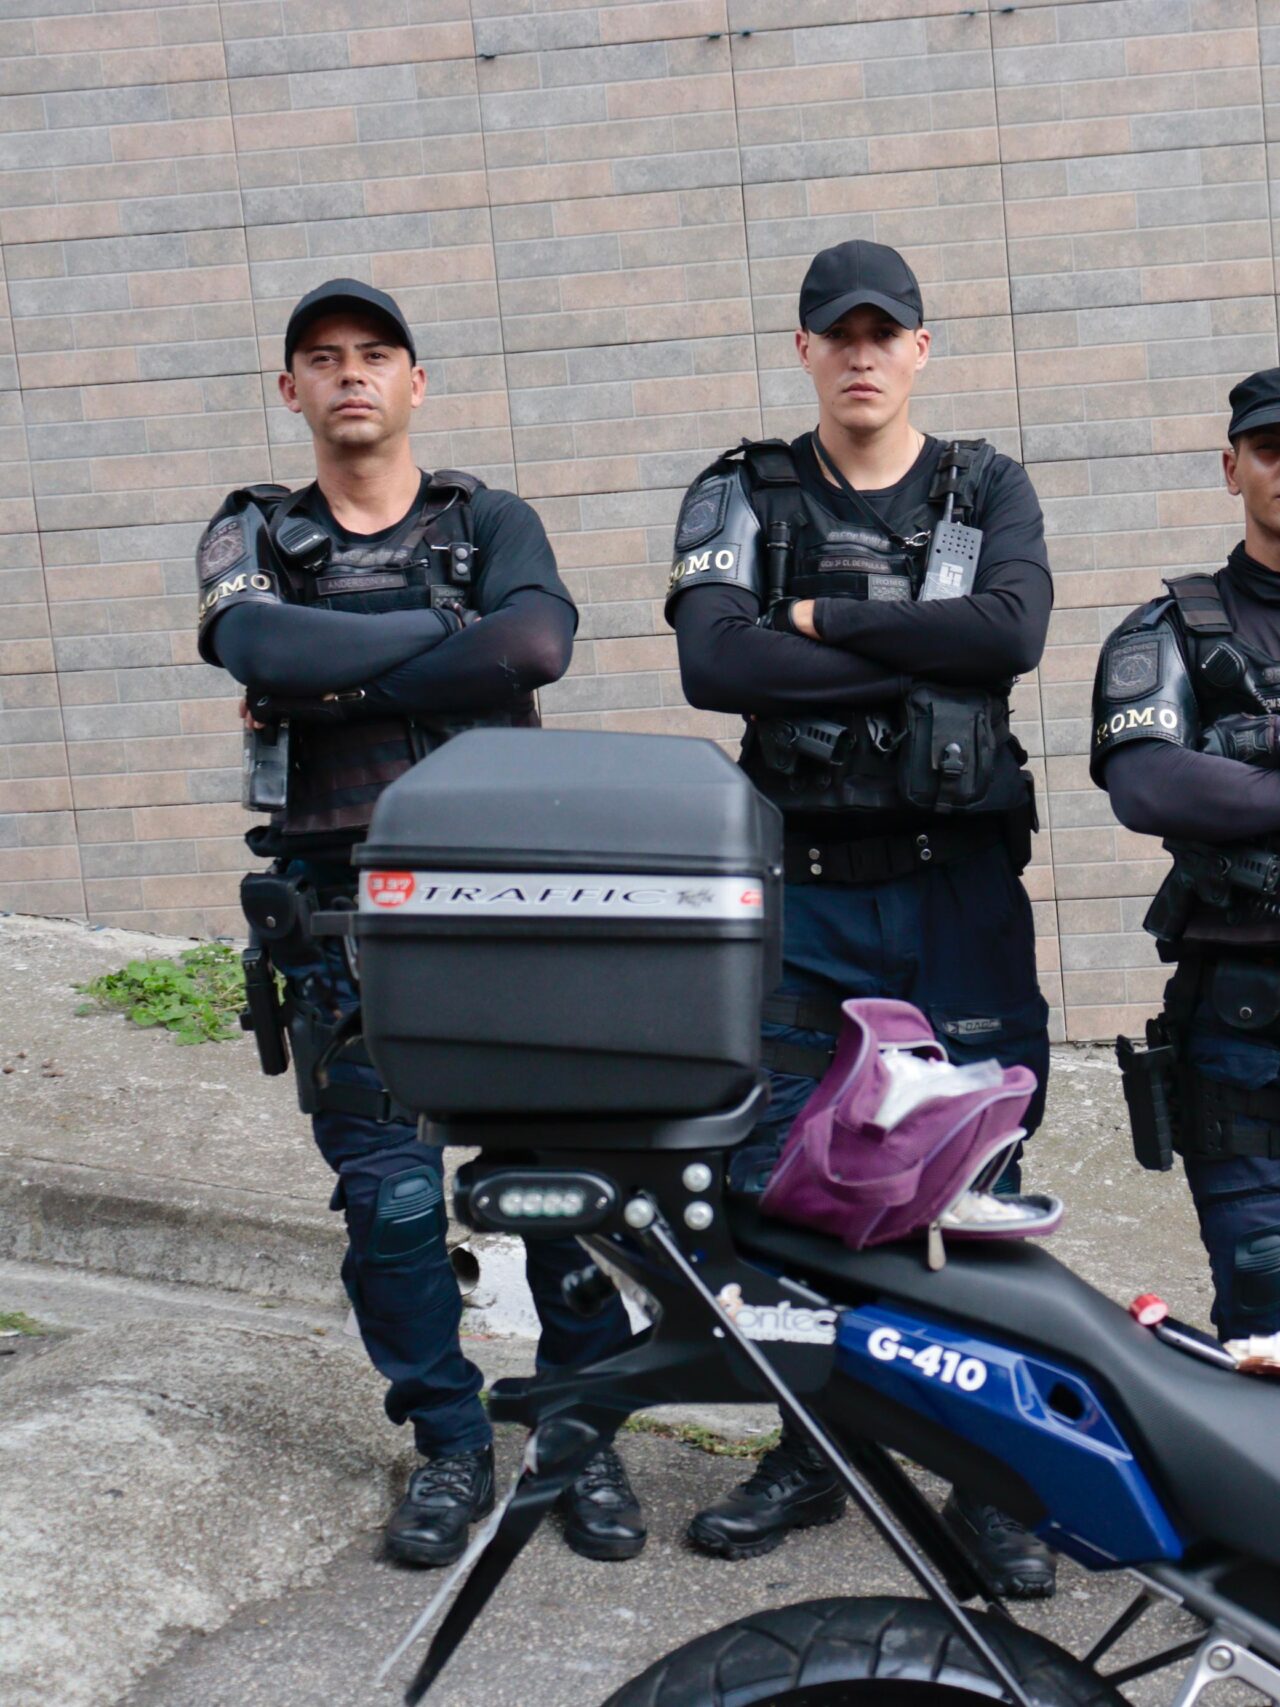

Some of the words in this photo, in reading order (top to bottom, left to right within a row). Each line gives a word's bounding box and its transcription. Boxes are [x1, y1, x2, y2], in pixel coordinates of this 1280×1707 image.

[1097, 706, 1179, 744] ROMO
[423, 886, 667, 904] TRAFFIC
[868, 1327, 987, 1392] G-410
